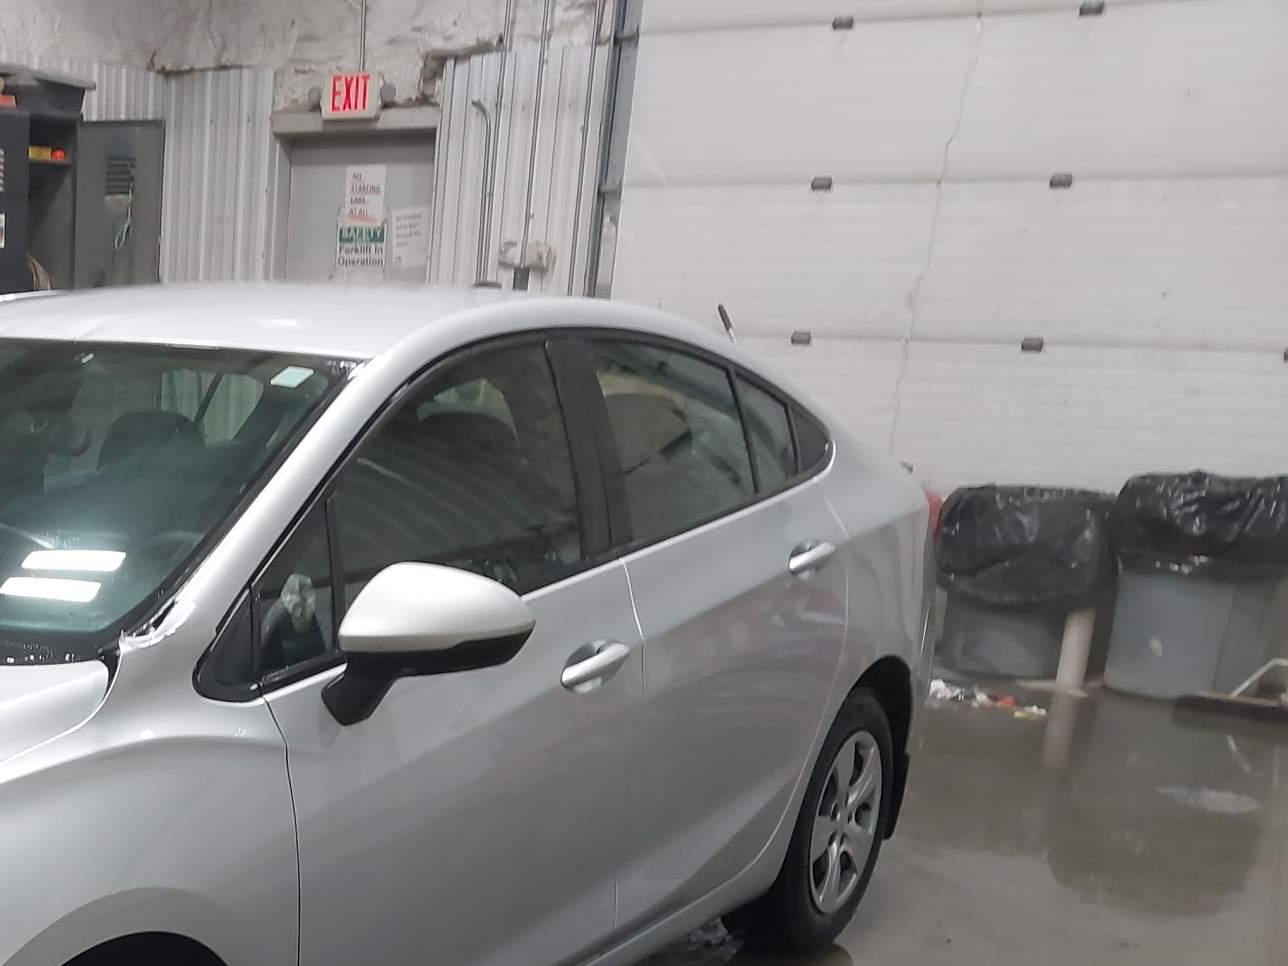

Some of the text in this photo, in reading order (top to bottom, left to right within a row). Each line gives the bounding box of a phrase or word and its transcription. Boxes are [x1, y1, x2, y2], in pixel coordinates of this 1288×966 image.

[331, 74, 370, 111] EXIT
[339, 244, 372, 255] Forklift
[337, 256, 384, 268] Operation
